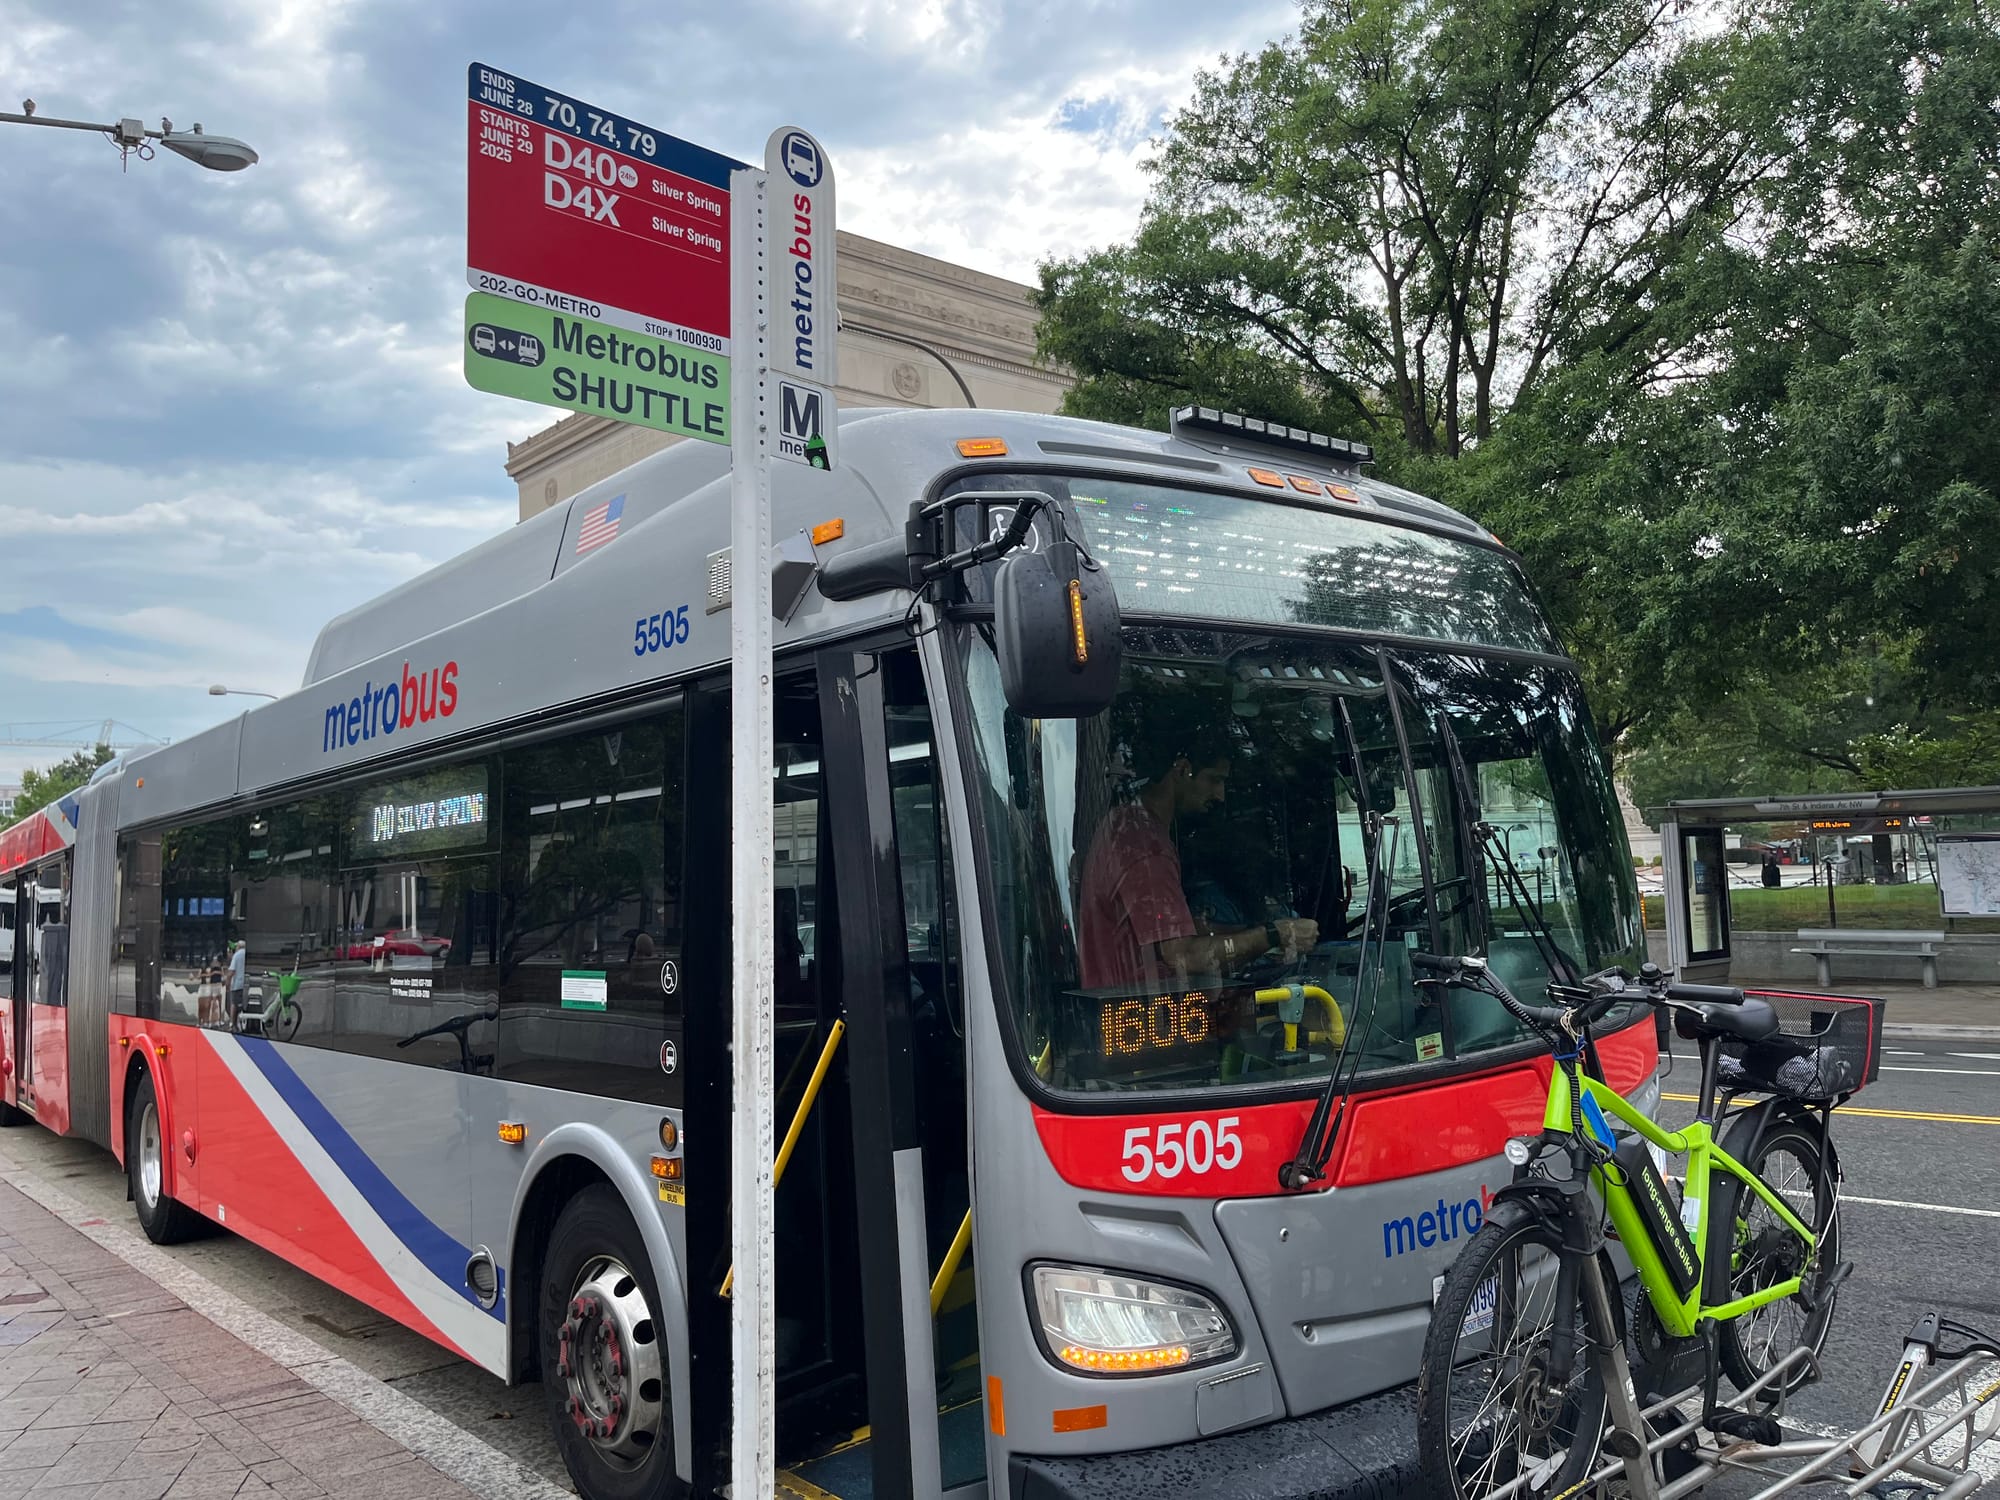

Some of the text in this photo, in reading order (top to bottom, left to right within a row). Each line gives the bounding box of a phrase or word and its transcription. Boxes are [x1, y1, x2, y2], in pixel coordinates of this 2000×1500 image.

[480, 69, 515, 93] ENDS
[480, 86, 533, 116] JUNE 28
[480, 109, 530, 137] STARTS
[480, 126, 534, 154] JUNE 29
[545, 96, 657, 157] 70, 74, 79
[480, 141, 512, 163] 2025
[545, 132, 617, 187] D40
[545, 171, 621, 227] D4X
[652, 179, 721, 217] Silver Spring
[652, 216, 721, 253] Silver Spring
[479, 275, 601, 319] 202-GO-METRO
[789, 193, 813, 369] metrobus
[552, 316, 719, 389] Metrobus
[645, 322, 722, 351] STOP# 1000930
[552, 366, 725, 437] SHUTTLE
[782, 386, 820, 437] M
[633, 604, 689, 657] 5505
[323, 661, 458, 753] metrobus
[373, 792, 483, 841] D40 SILVER SPRING
[1850, 800, 1863, 808] NW
[1102, 992, 1208, 1056] 1606
[1121, 1116, 1242, 1183] 5505
[659, 1182, 684, 1195] KNEELING
[666, 1193, 678, 1204] BUS
[1641, 1165, 1676, 1237] long-range
[1673, 1237, 1694, 1277] e-bike
